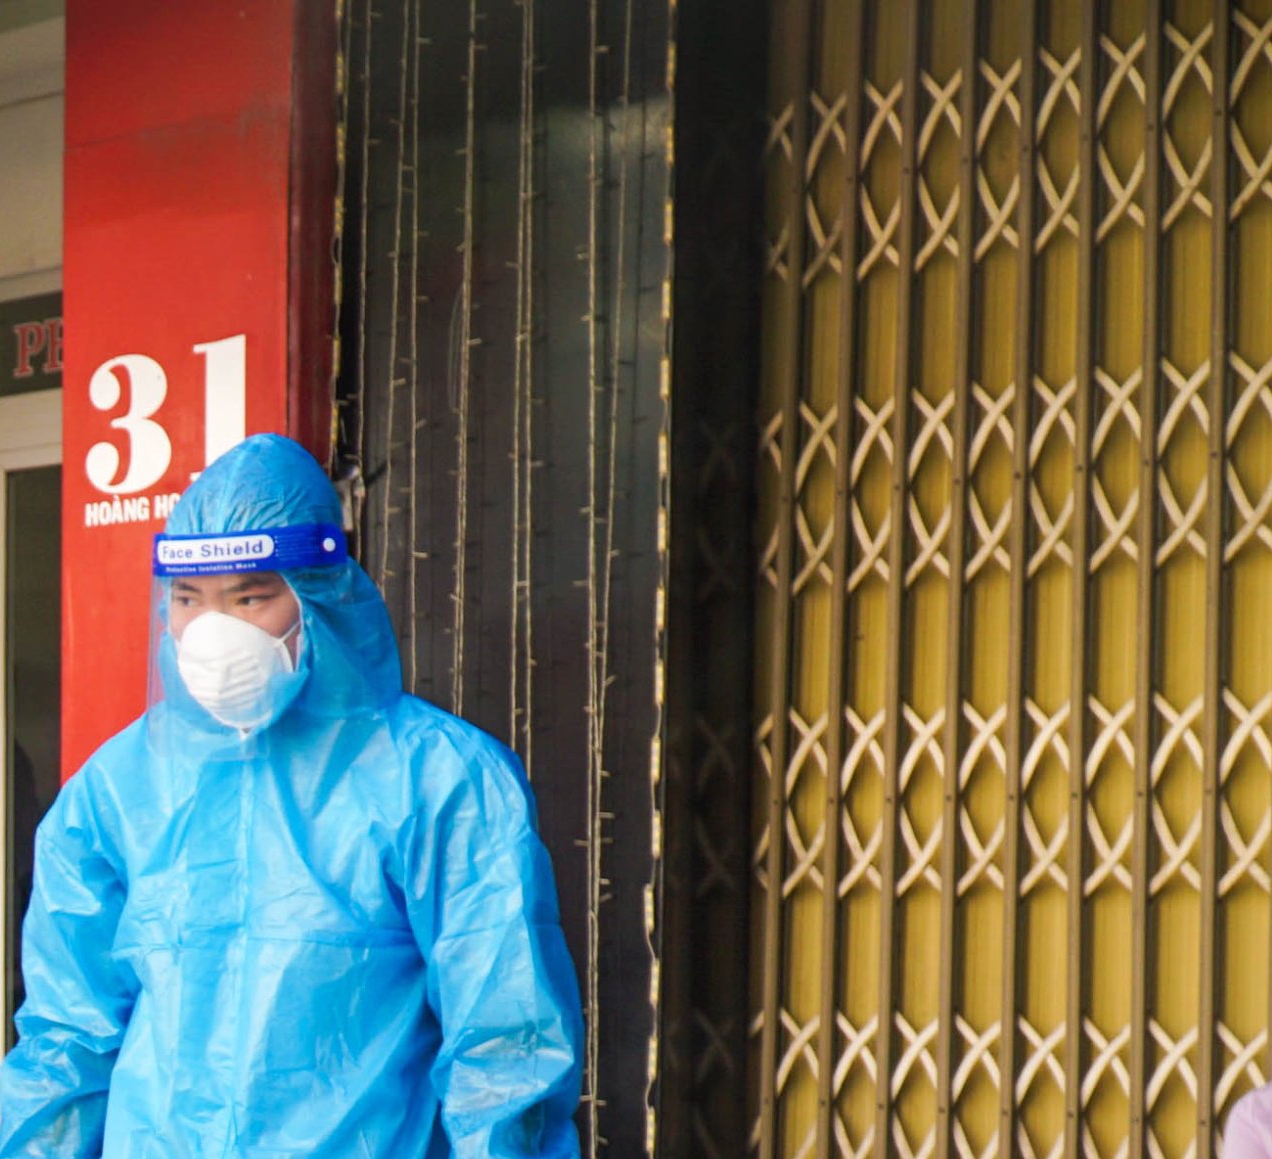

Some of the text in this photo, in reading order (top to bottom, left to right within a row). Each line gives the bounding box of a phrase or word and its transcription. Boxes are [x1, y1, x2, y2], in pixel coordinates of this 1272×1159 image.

[85, 334, 246, 494] 31
[85, 493, 183, 527] HOÀNG HO
[162, 540, 264, 560] Face Shield
